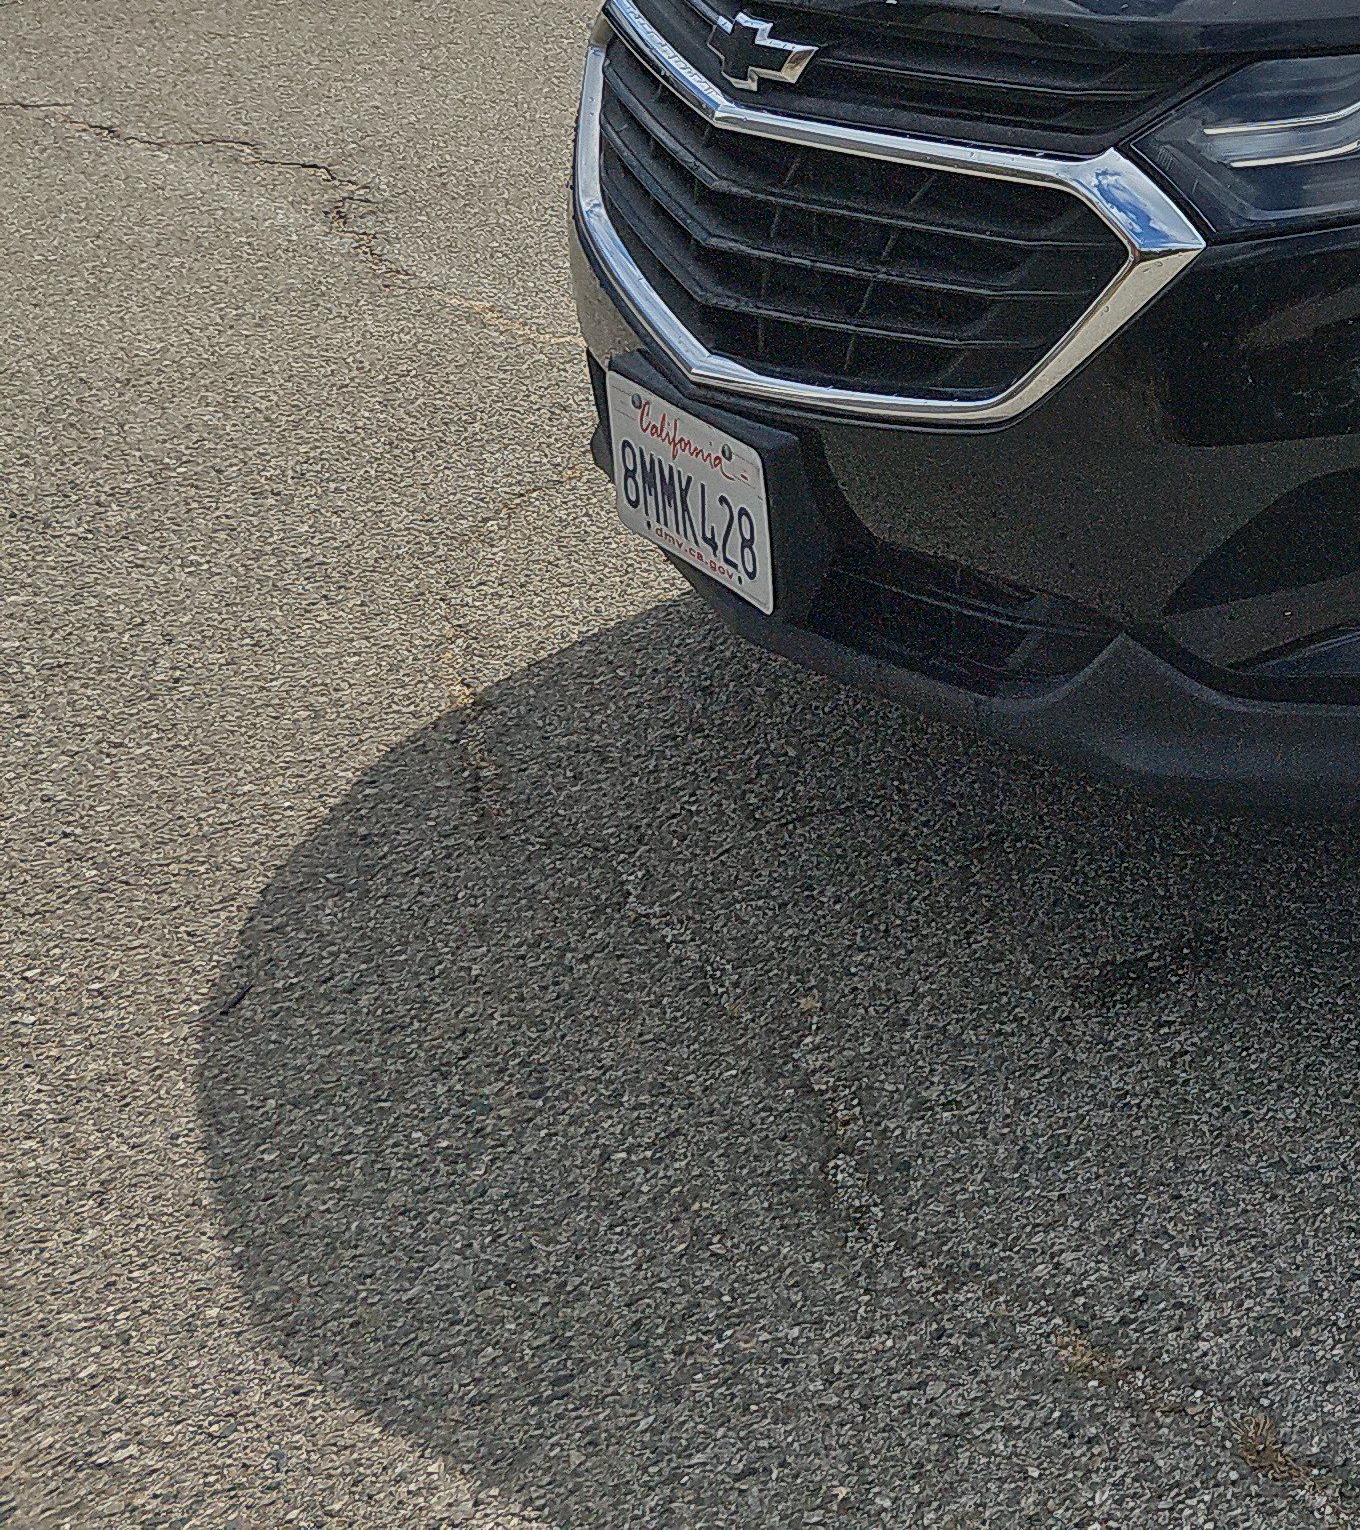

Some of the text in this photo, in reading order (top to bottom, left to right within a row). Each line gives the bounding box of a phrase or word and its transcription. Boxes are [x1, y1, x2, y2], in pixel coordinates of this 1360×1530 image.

[638, 401, 736, 481] California
[621, 438, 757, 581] 8MMK428
[654, 525, 735, 581] dmv.ca.gov
